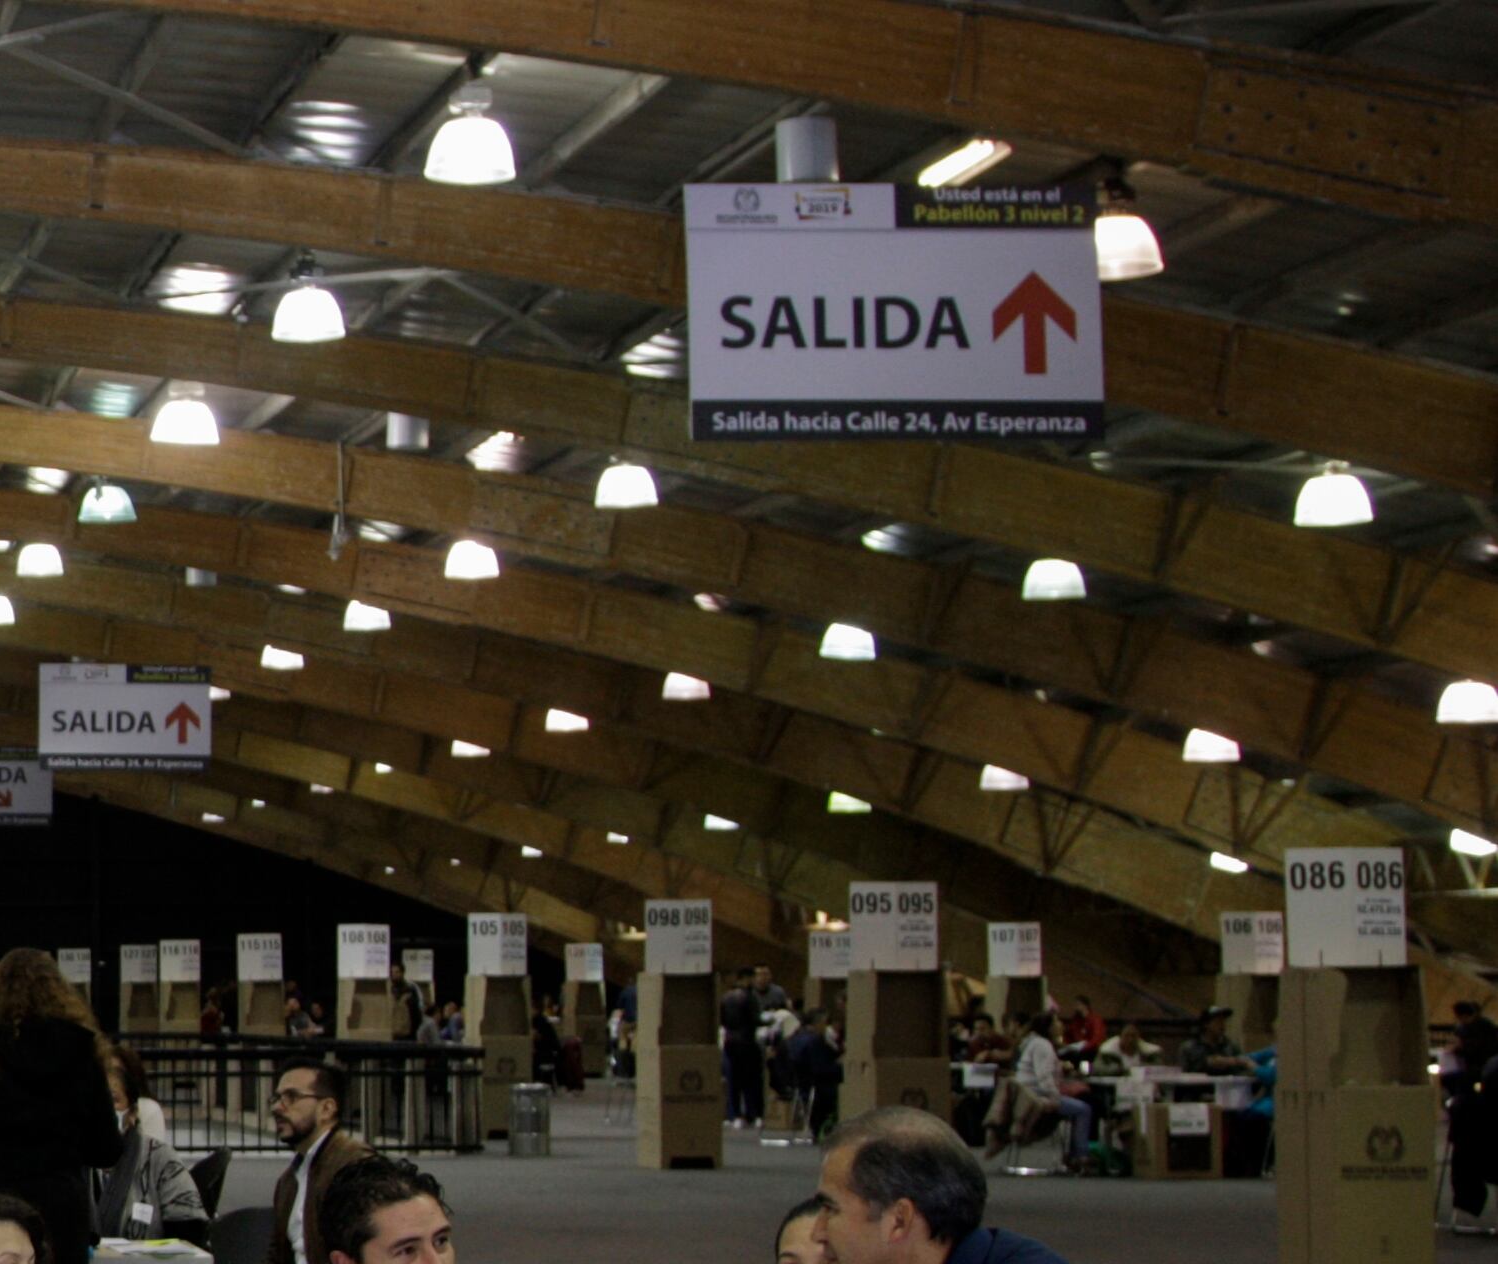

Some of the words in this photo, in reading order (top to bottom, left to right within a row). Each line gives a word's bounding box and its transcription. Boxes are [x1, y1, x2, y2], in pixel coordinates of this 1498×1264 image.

[933, 186, 982, 202] Usted
[1021, 189, 1040, 202] en
[1044, 187, 1061, 202] el
[913, 203, 1000, 223] Pabellón
[1004, 205, 1015, 223] 3
[1019, 203, 1067, 223] nivel
[1073, 205, 1085, 222] 2
[719, 295, 971, 350] SALIDA
[712, 410, 779, 433] Salida
[784, 410, 842, 433] hacia
[846, 410, 900, 433] Calle
[904, 413, 938, 435] 24,
[942, 413, 971, 432] Av
[976, 413, 1087, 436] Esperanza
[52, 709, 155, 734] SALIDA
[1290, 861, 1346, 891] 086
[1357, 861, 1403, 890] 086
[851, 891, 893, 915] 095
[898, 892, 935, 915] 095
[647, 908, 681, 927] 098
[684, 907, 709, 926] 098
[1223, 918, 1253, 935] 106
[471, 920, 498, 937] 105
